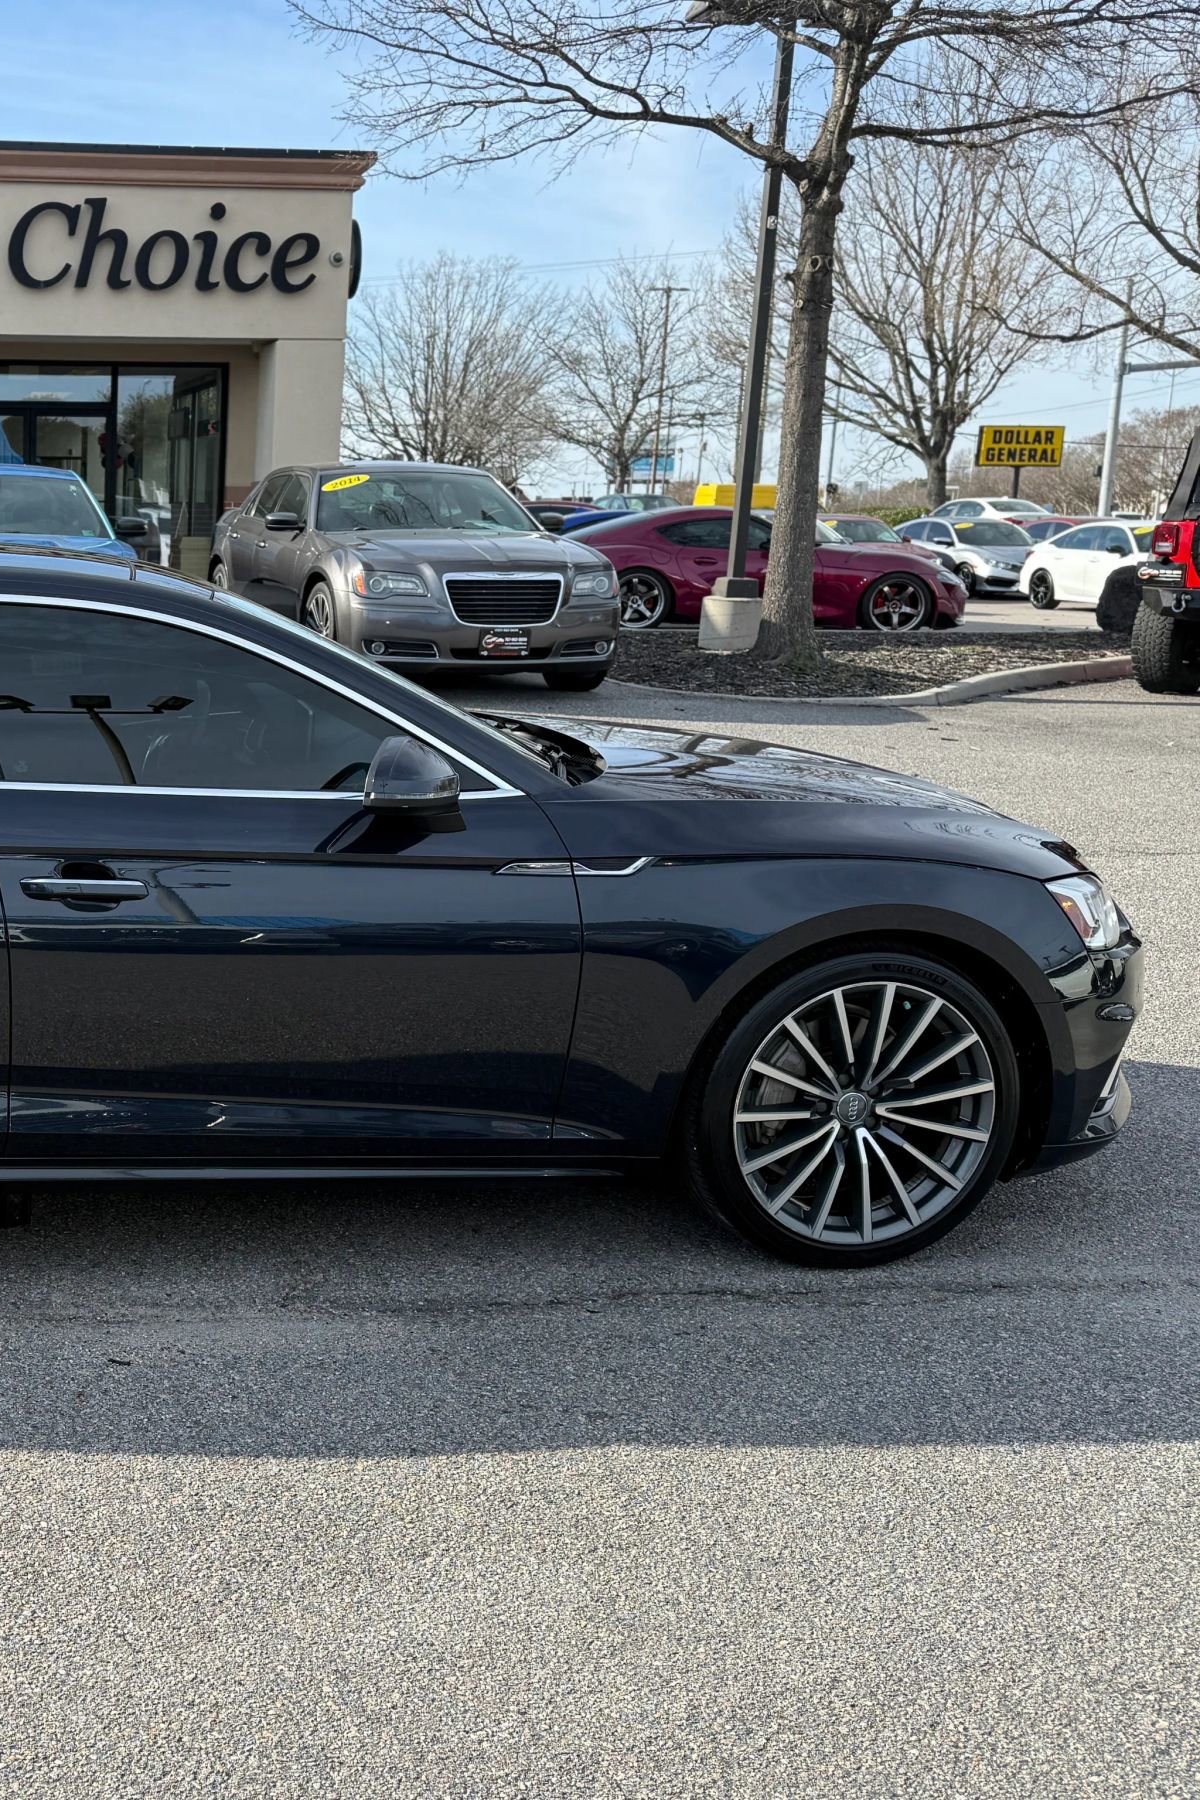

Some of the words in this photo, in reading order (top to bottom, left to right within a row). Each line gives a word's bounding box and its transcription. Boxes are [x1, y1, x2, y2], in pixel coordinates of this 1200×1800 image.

[8, 197, 320, 294] Choice
[992, 429, 1055, 445] DOLLAR
[986, 447, 1058, 463] GENERAL
[331, 476, 361, 489] 2014
[888, 964, 945, 984] MICHELIN
